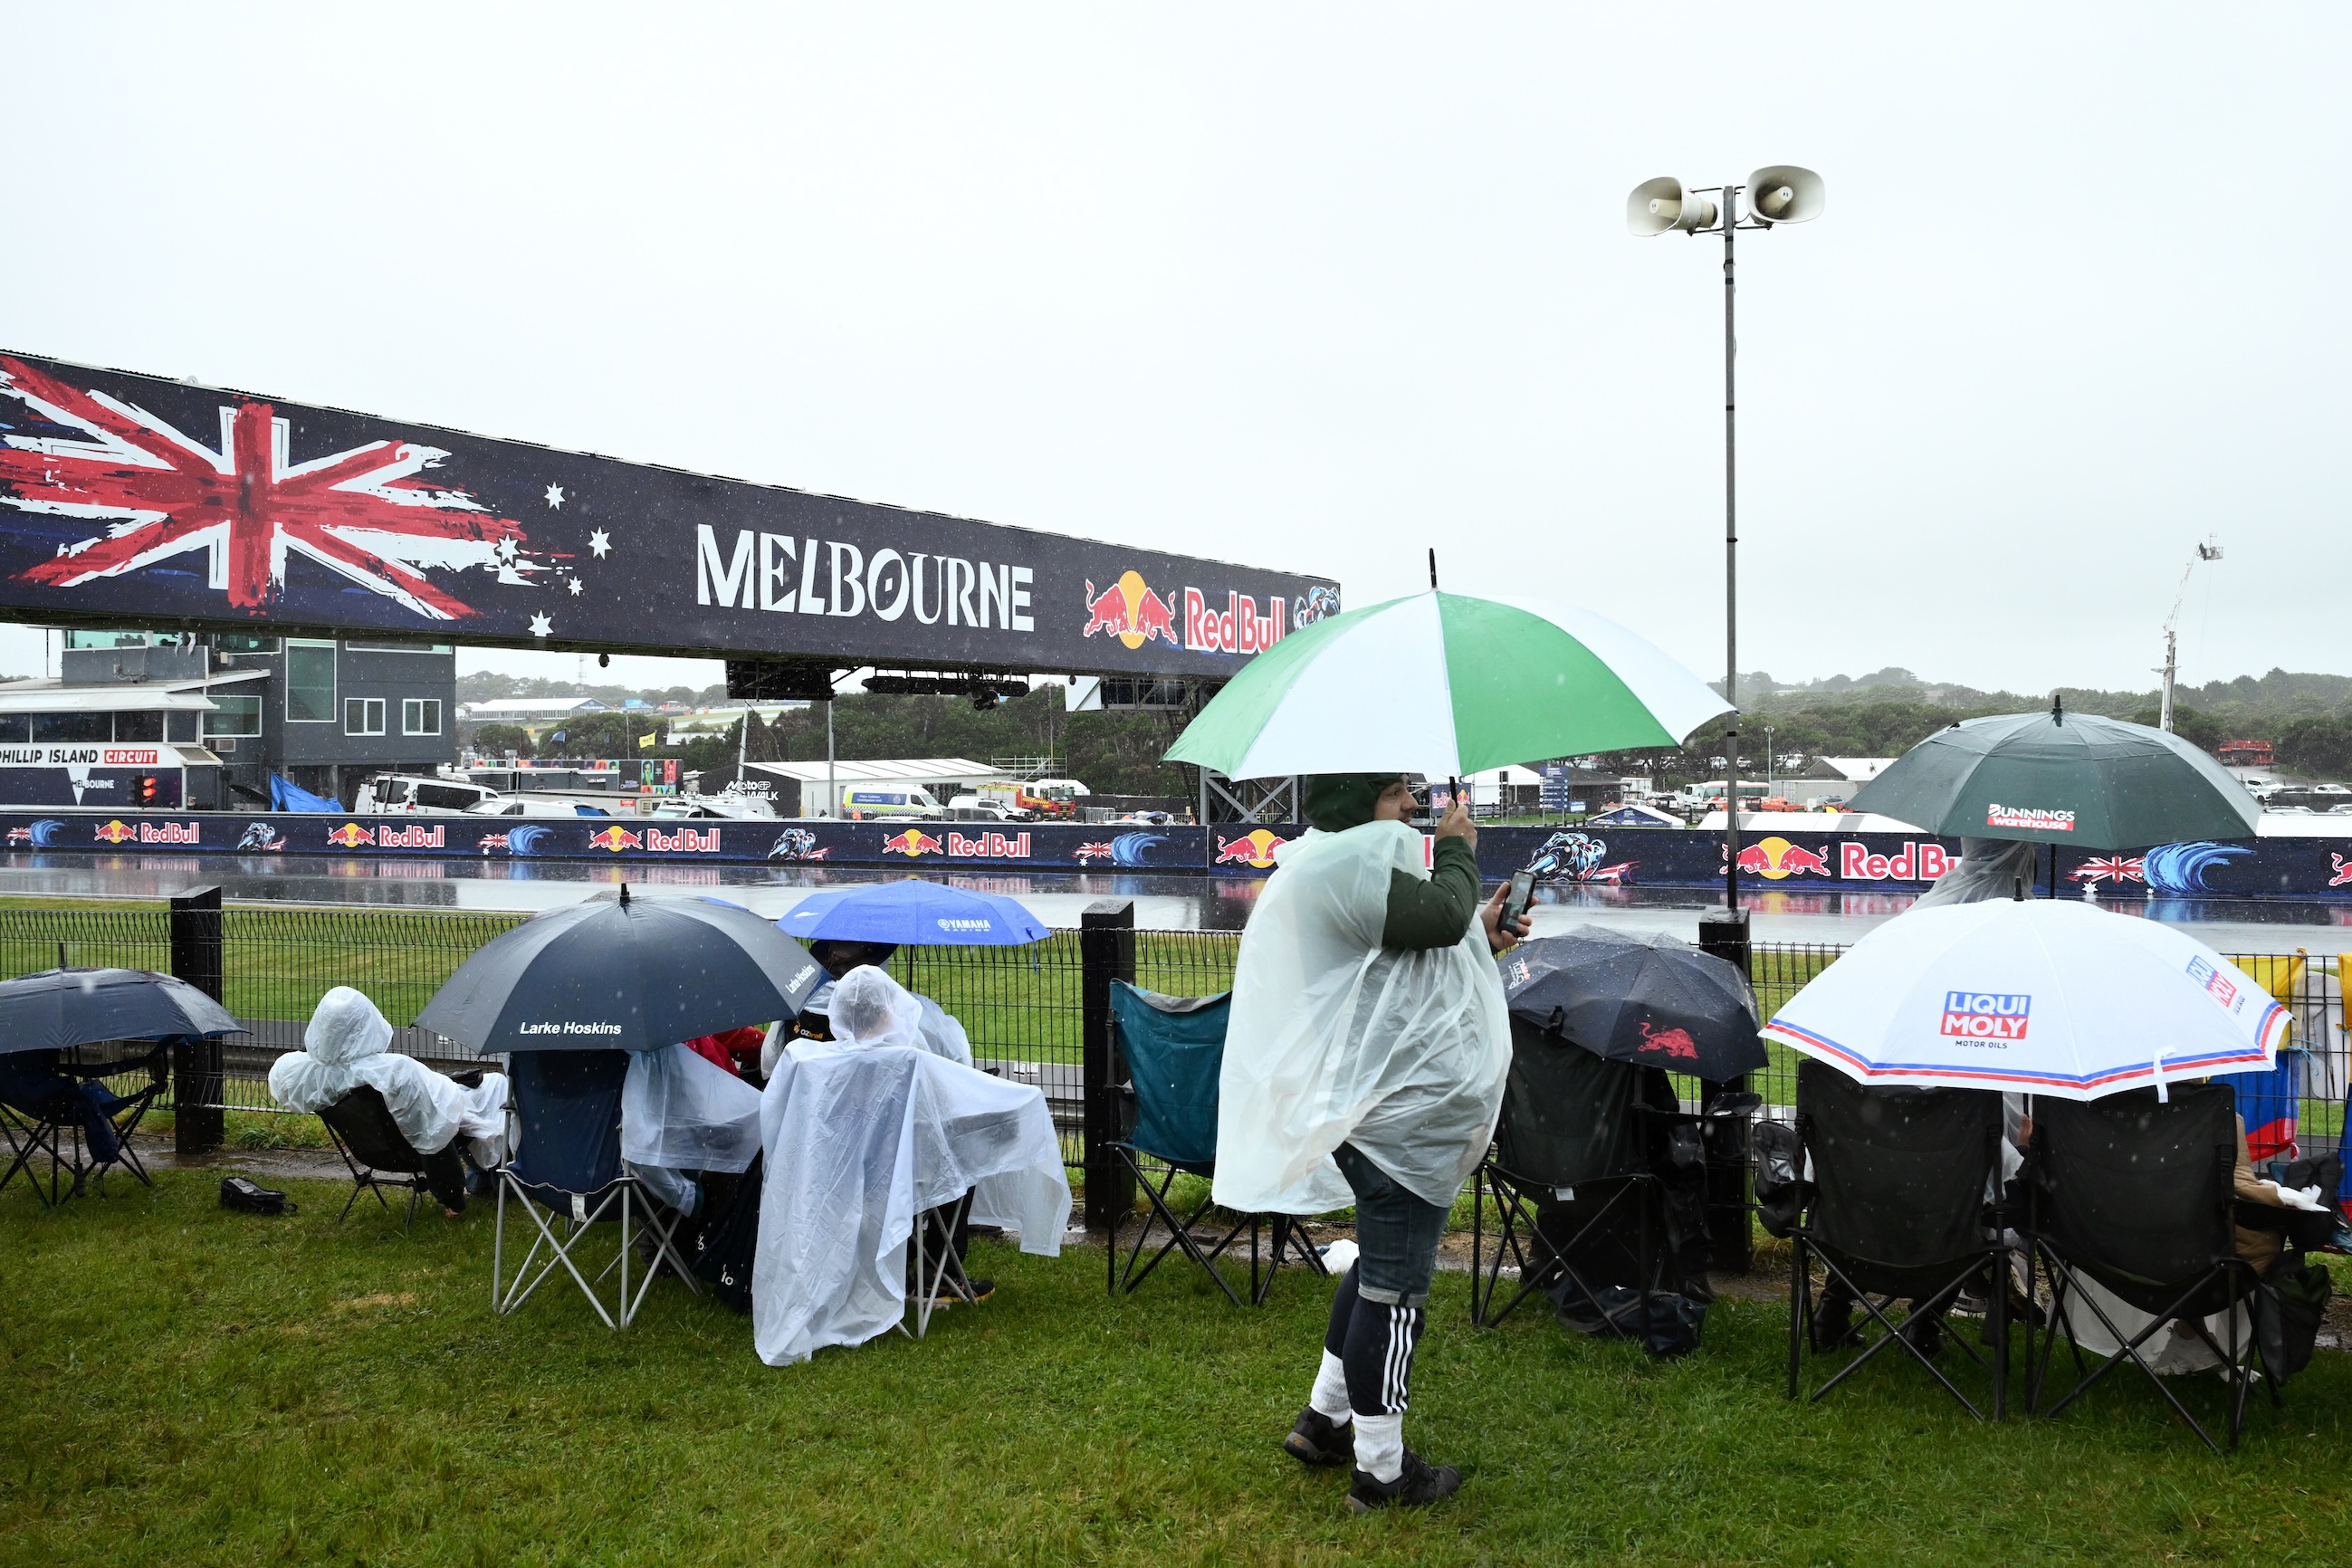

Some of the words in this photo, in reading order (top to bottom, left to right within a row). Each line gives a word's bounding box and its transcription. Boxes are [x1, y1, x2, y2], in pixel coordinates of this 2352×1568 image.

[697, 523, 1035, 632] MELBOURNE
[0, 750, 42, 763] HILLIP
[49, 750, 98, 763] ISLAND
[105, 751, 156, 764] CIRCUIT
[72, 779, 114, 789] MELBOURNE
[1988, 803, 2076, 822] BUNNINGS
[1993, 817, 2068, 830] warehouse
[949, 919, 991, 929] YAMAHA
[2186, 956, 2214, 988] LIQUI
[2208, 972, 2236, 1007] MOLY
[1948, 992, 2028, 1015] LIQUI
[520, 1021, 560, 1035] Larke
[563, 1021, 622, 1035] Hoskins
[1944, 1014, 2027, 1037] MOLY
[1988, 1041, 2008, 1049] OILS
